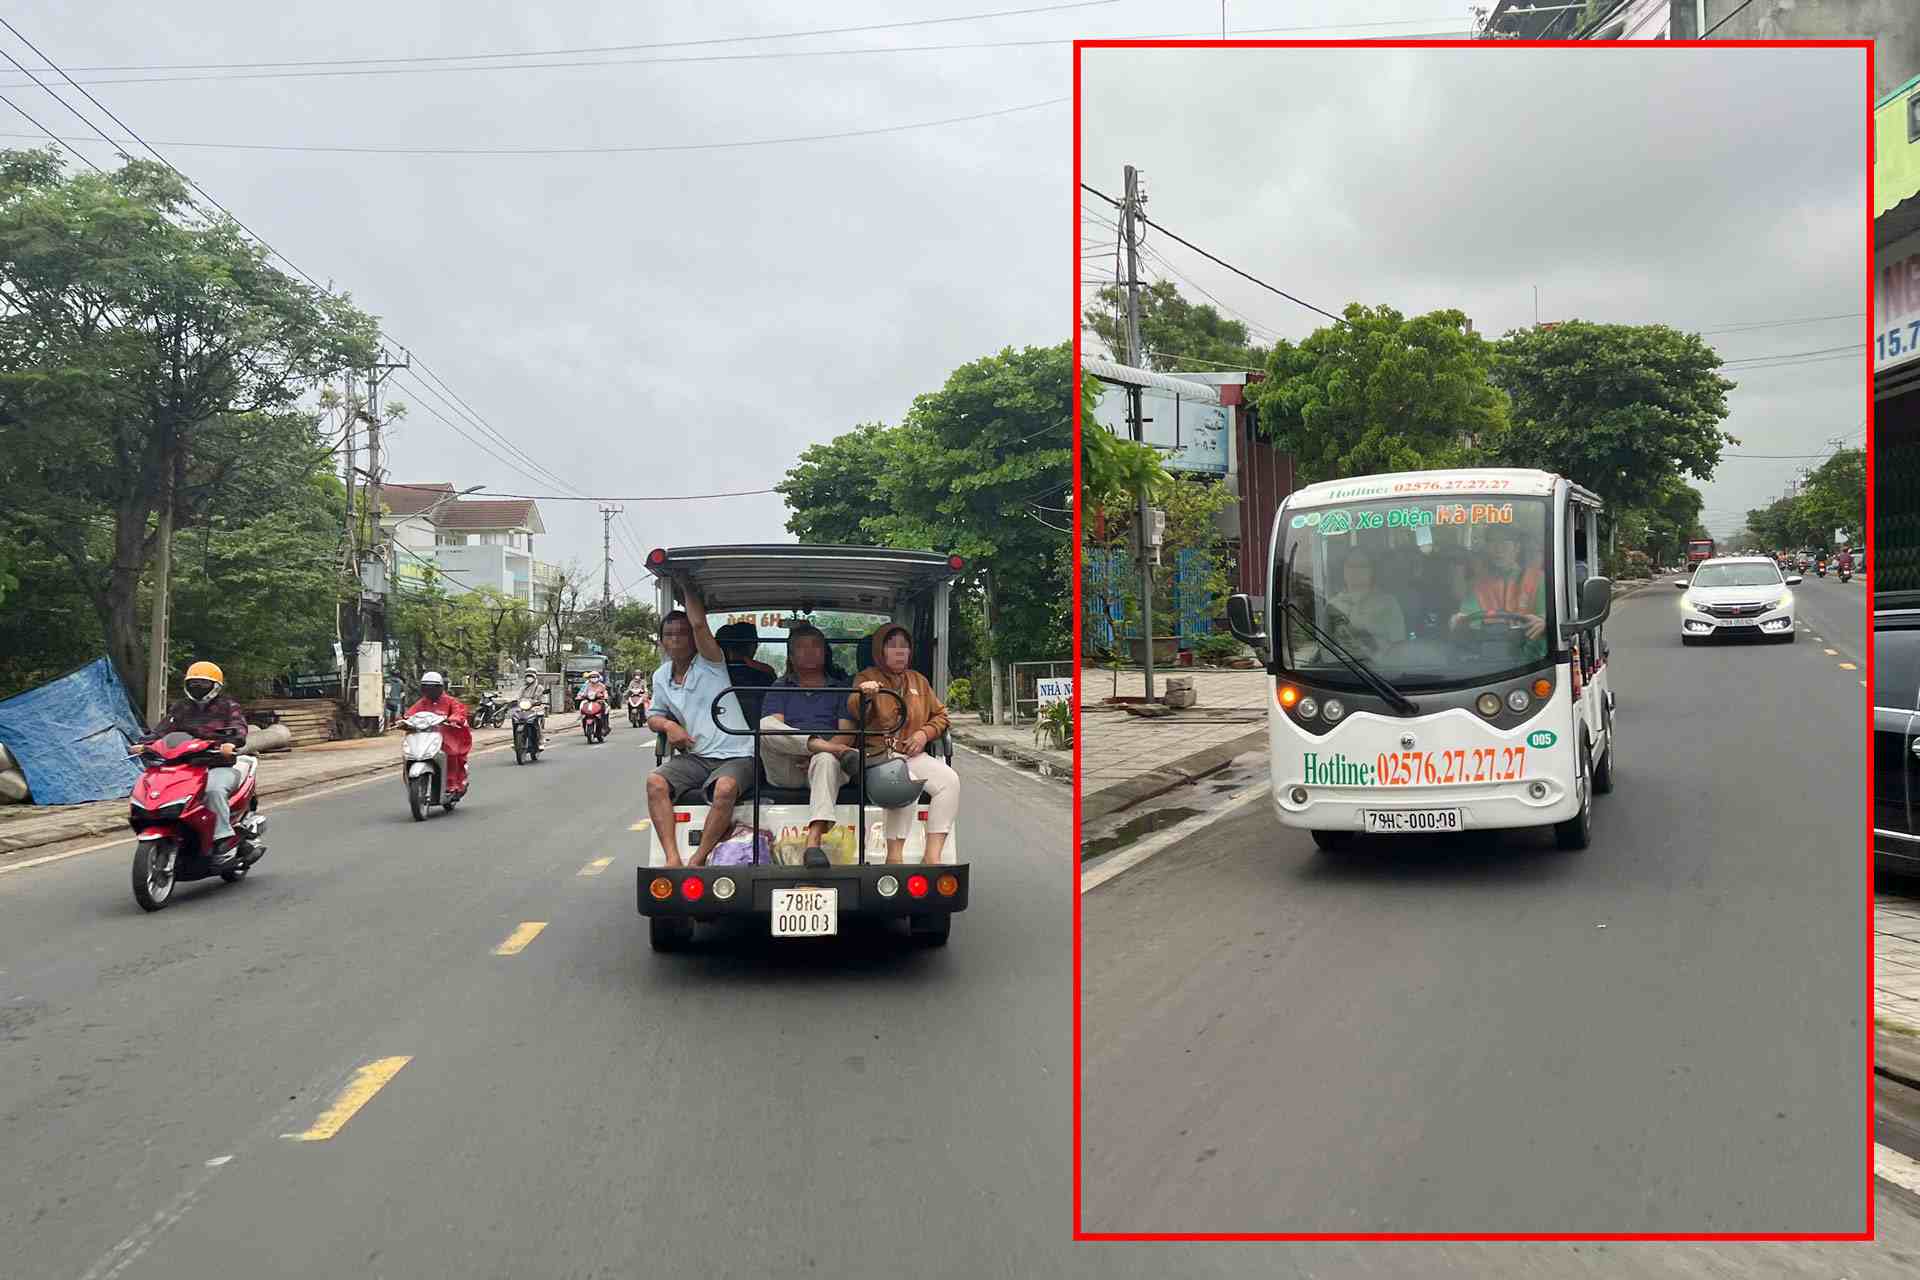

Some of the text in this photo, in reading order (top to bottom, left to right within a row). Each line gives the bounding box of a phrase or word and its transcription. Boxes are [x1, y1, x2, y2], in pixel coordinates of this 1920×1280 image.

[1329, 479, 1511, 500] Hotline: 02576.27.27.27
[1357, 511, 1384, 530] Xe
[1387, 507, 1433, 531] Điện
[1471, 503, 1514, 524] Phú
[1532, 732, 1553, 746] 005
[1303, 747, 1526, 785] Hotline: 02576.27.27.27
